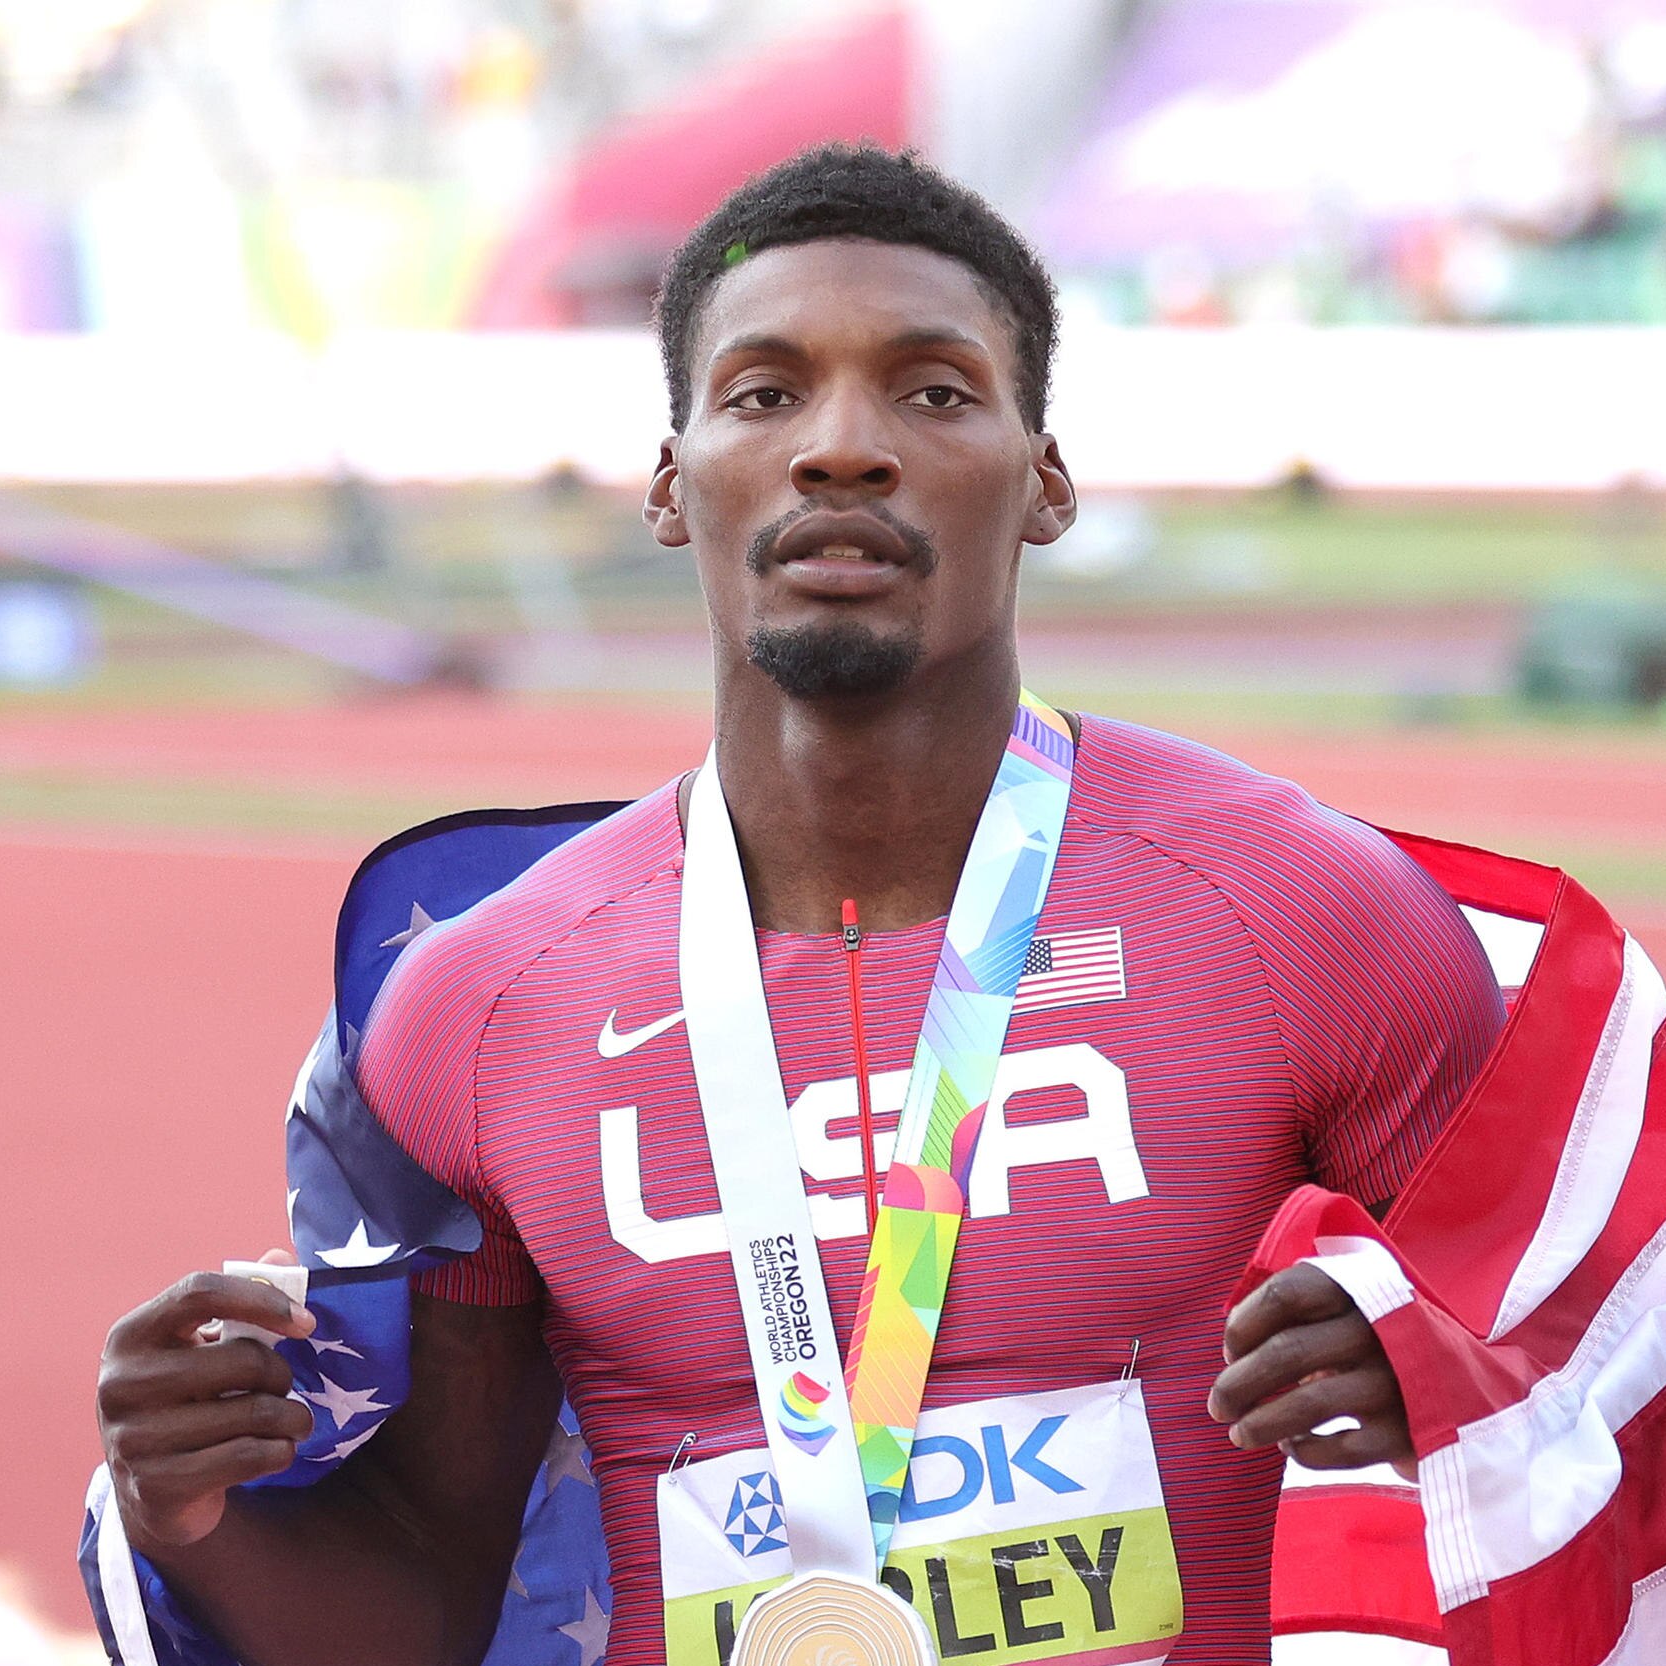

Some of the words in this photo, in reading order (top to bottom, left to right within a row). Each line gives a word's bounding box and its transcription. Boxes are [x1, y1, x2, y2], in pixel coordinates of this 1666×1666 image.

[600, 1043, 1150, 1264] USA
[750, 1241, 773, 1311] ATHLETICS
[763, 1238, 797, 1362] CHAMPIONSHIPS
[765, 1316, 783, 1364] WORLD
[898, 1414, 1087, 1524] DK
